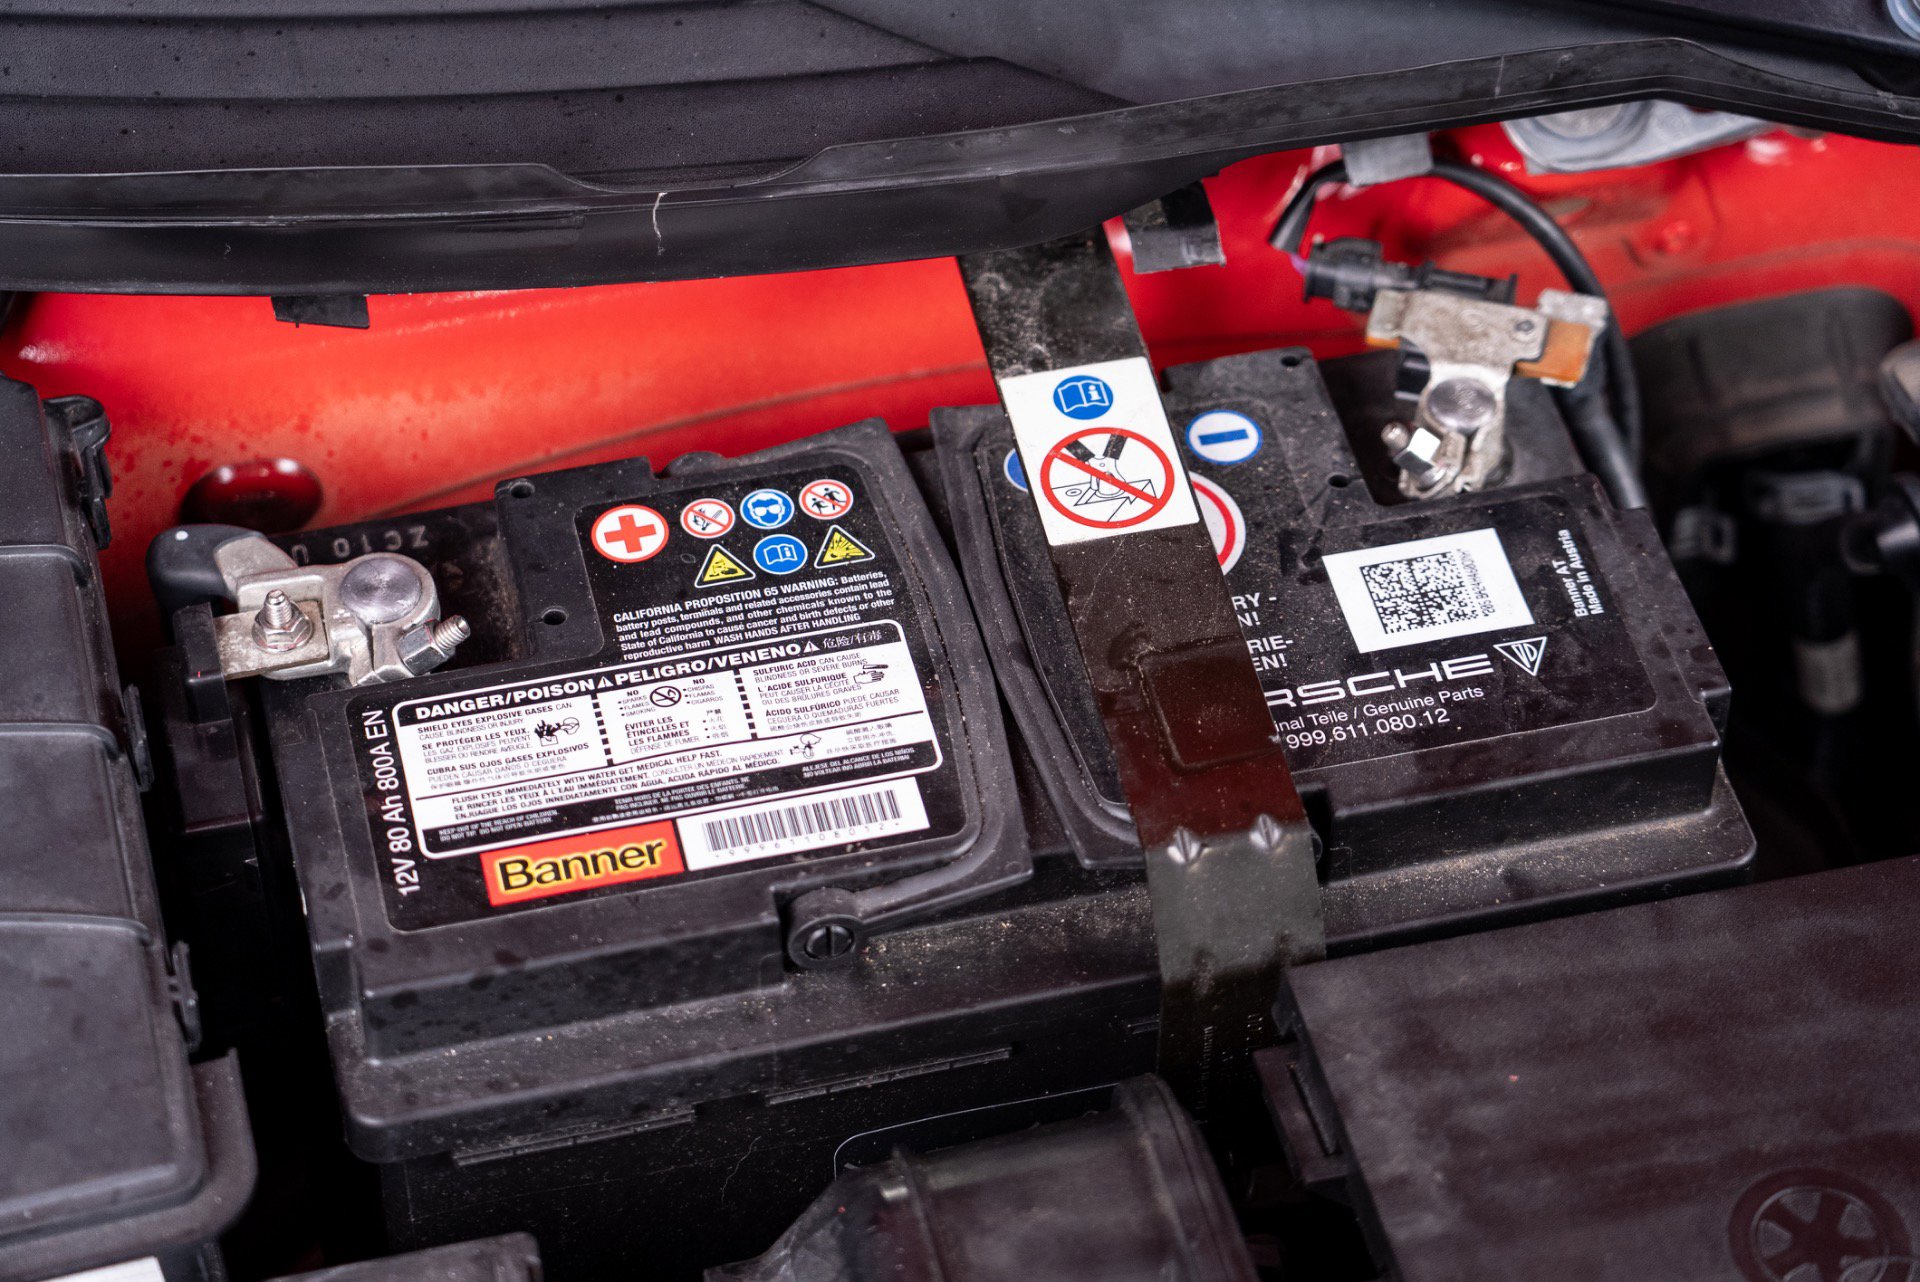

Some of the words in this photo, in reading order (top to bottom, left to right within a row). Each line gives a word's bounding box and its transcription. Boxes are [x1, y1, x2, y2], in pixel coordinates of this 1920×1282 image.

[1554, 528, 1585, 570] Austria
[1551, 558, 1571, 576] AT
[1573, 570, 1590, 583] in
[612, 603, 682, 622] CALIFORNIA
[684, 589, 761, 610] PROPOSITION
[763, 586, 779, 596] 65
[780, 576, 839, 593] WARNING:
[840, 569, 887, 584] Batteries,
[615, 620, 650, 633] battery
[650, 614, 680, 627] posts,
[679, 606, 723, 621] terminals
[724, 603, 743, 613] and
[743, 597, 777, 610] related
[777, 588, 832, 604] accessories
[832, 582, 868, 595] contain
[868, 578, 890, 589] lead
[1559, 576, 1589, 617] Banner
[1578, 583, 1605, 615] Made
[618, 631, 637, 641] and
[639, 627, 661, 637] lead
[663, 616, 724, 635] compounds,
[725, 612, 745, 622] and
[746, 607, 773, 619] other
[775, 599, 825, 614] chemicals
[827, 593, 861, 605] known
[863, 591, 873, 599] to
[875, 588, 892, 597] the
[620, 640, 646, 650] State
[646, 637, 657, 646] of
[658, 629, 703, 644] California
[704, 628, 715, 636] to
[716, 623, 744, 634] cause
[746, 618, 778, 628] cancer
[779, 613, 797, 623] and
[798, 609, 822, 620] birth
[822, 603, 857, 616] defects
[869, 597, 895, 608] other
[623, 643, 684, 661] reproductive
[684, 638, 710, 650] harm
[713, 632, 743, 644] WASH
[744, 626, 778, 639] HANDS
[779, 621, 810, 633] AFTER
[810, 612, 861, 628] HANDLING
[415, 676, 602, 719] DANGER/POISON
[614, 641, 804, 686] PELIGRO/VENENO
[752, 663, 794, 676] SULFURIC
[796, 659, 817, 668] ACID
[818, 656, 834, 664] CAN
[836, 652, 860, 661] CAUSE
[754, 670, 797, 683] BLINDNESS
[811, 663, 839, 673] SEVERE
[841, 658, 868, 668] BURNS
[794, 672, 846, 686] SULFURIQUE
[692, 677, 705, 685] NO
[417, 722, 448, 733] SHIELD
[450, 718, 473, 728] EYES
[475, 710, 522, 724] EXPLOSIVE
[524, 705, 553, 715] GASES
[555, 701, 572, 710] CAN
[793, 698, 841, 714] SULFÚRICO
[1306, 708, 1349, 726] Teile
[1361, 693, 1435, 717] Genuine
[1437, 684, 1485, 703] Parts
[361, 709, 388, 739] EN
[435, 733, 481, 748] PROTÉGER
[484, 731, 500, 740] LES
[503, 726, 529, 737] YEUX.
[624, 719, 655, 730] ÉVITER
[656, 716, 673, 724] LES
[626, 722, 678, 738] ÉTINCELLES
[679, 720, 690, 728] ET
[628, 737, 644, 746] LES
[646, 729, 690, 742] FLAMMES
[1284, 706, 1450, 750] 999.611.080.12
[367, 740, 400, 791] 800A
[427, 765, 456, 776] CUBRA
[459, 762, 476, 771] SUS
[479, 758, 502, 768] OJOS
[504, 753, 533, 764] GASES
[535, 742, 589, 758] EXPLOSIVOS
[451, 793, 479, 804] FLUSH
[480, 789, 502, 799] EYES
[504, 779, 561, 794] IMMEDIATELY
[563, 775, 585, 784] WITH
[587, 770, 616, 780] WATER
[618, 766, 634, 774] GET
[636, 758, 674, 771] MEDICAL
[676, 754, 697, 763] HELP
[699, 749, 722, 759] FAST.
[501, 803, 517, 812] LOS
[520, 799, 542, 808] OJOS
[620, 782, 638, 791] CON
[640, 777, 666, 788] AGUA,
[667, 772, 695, 782] ACUDA
[697, 765, 729, 777] RÁPIDO
[744, 756, 780, 769] MÉDICO.
[379, 793, 407, 824] Ah
[385, 825, 414, 853] 80
[391, 853, 422, 896] 12V
[496, 833, 668, 892] Banner
